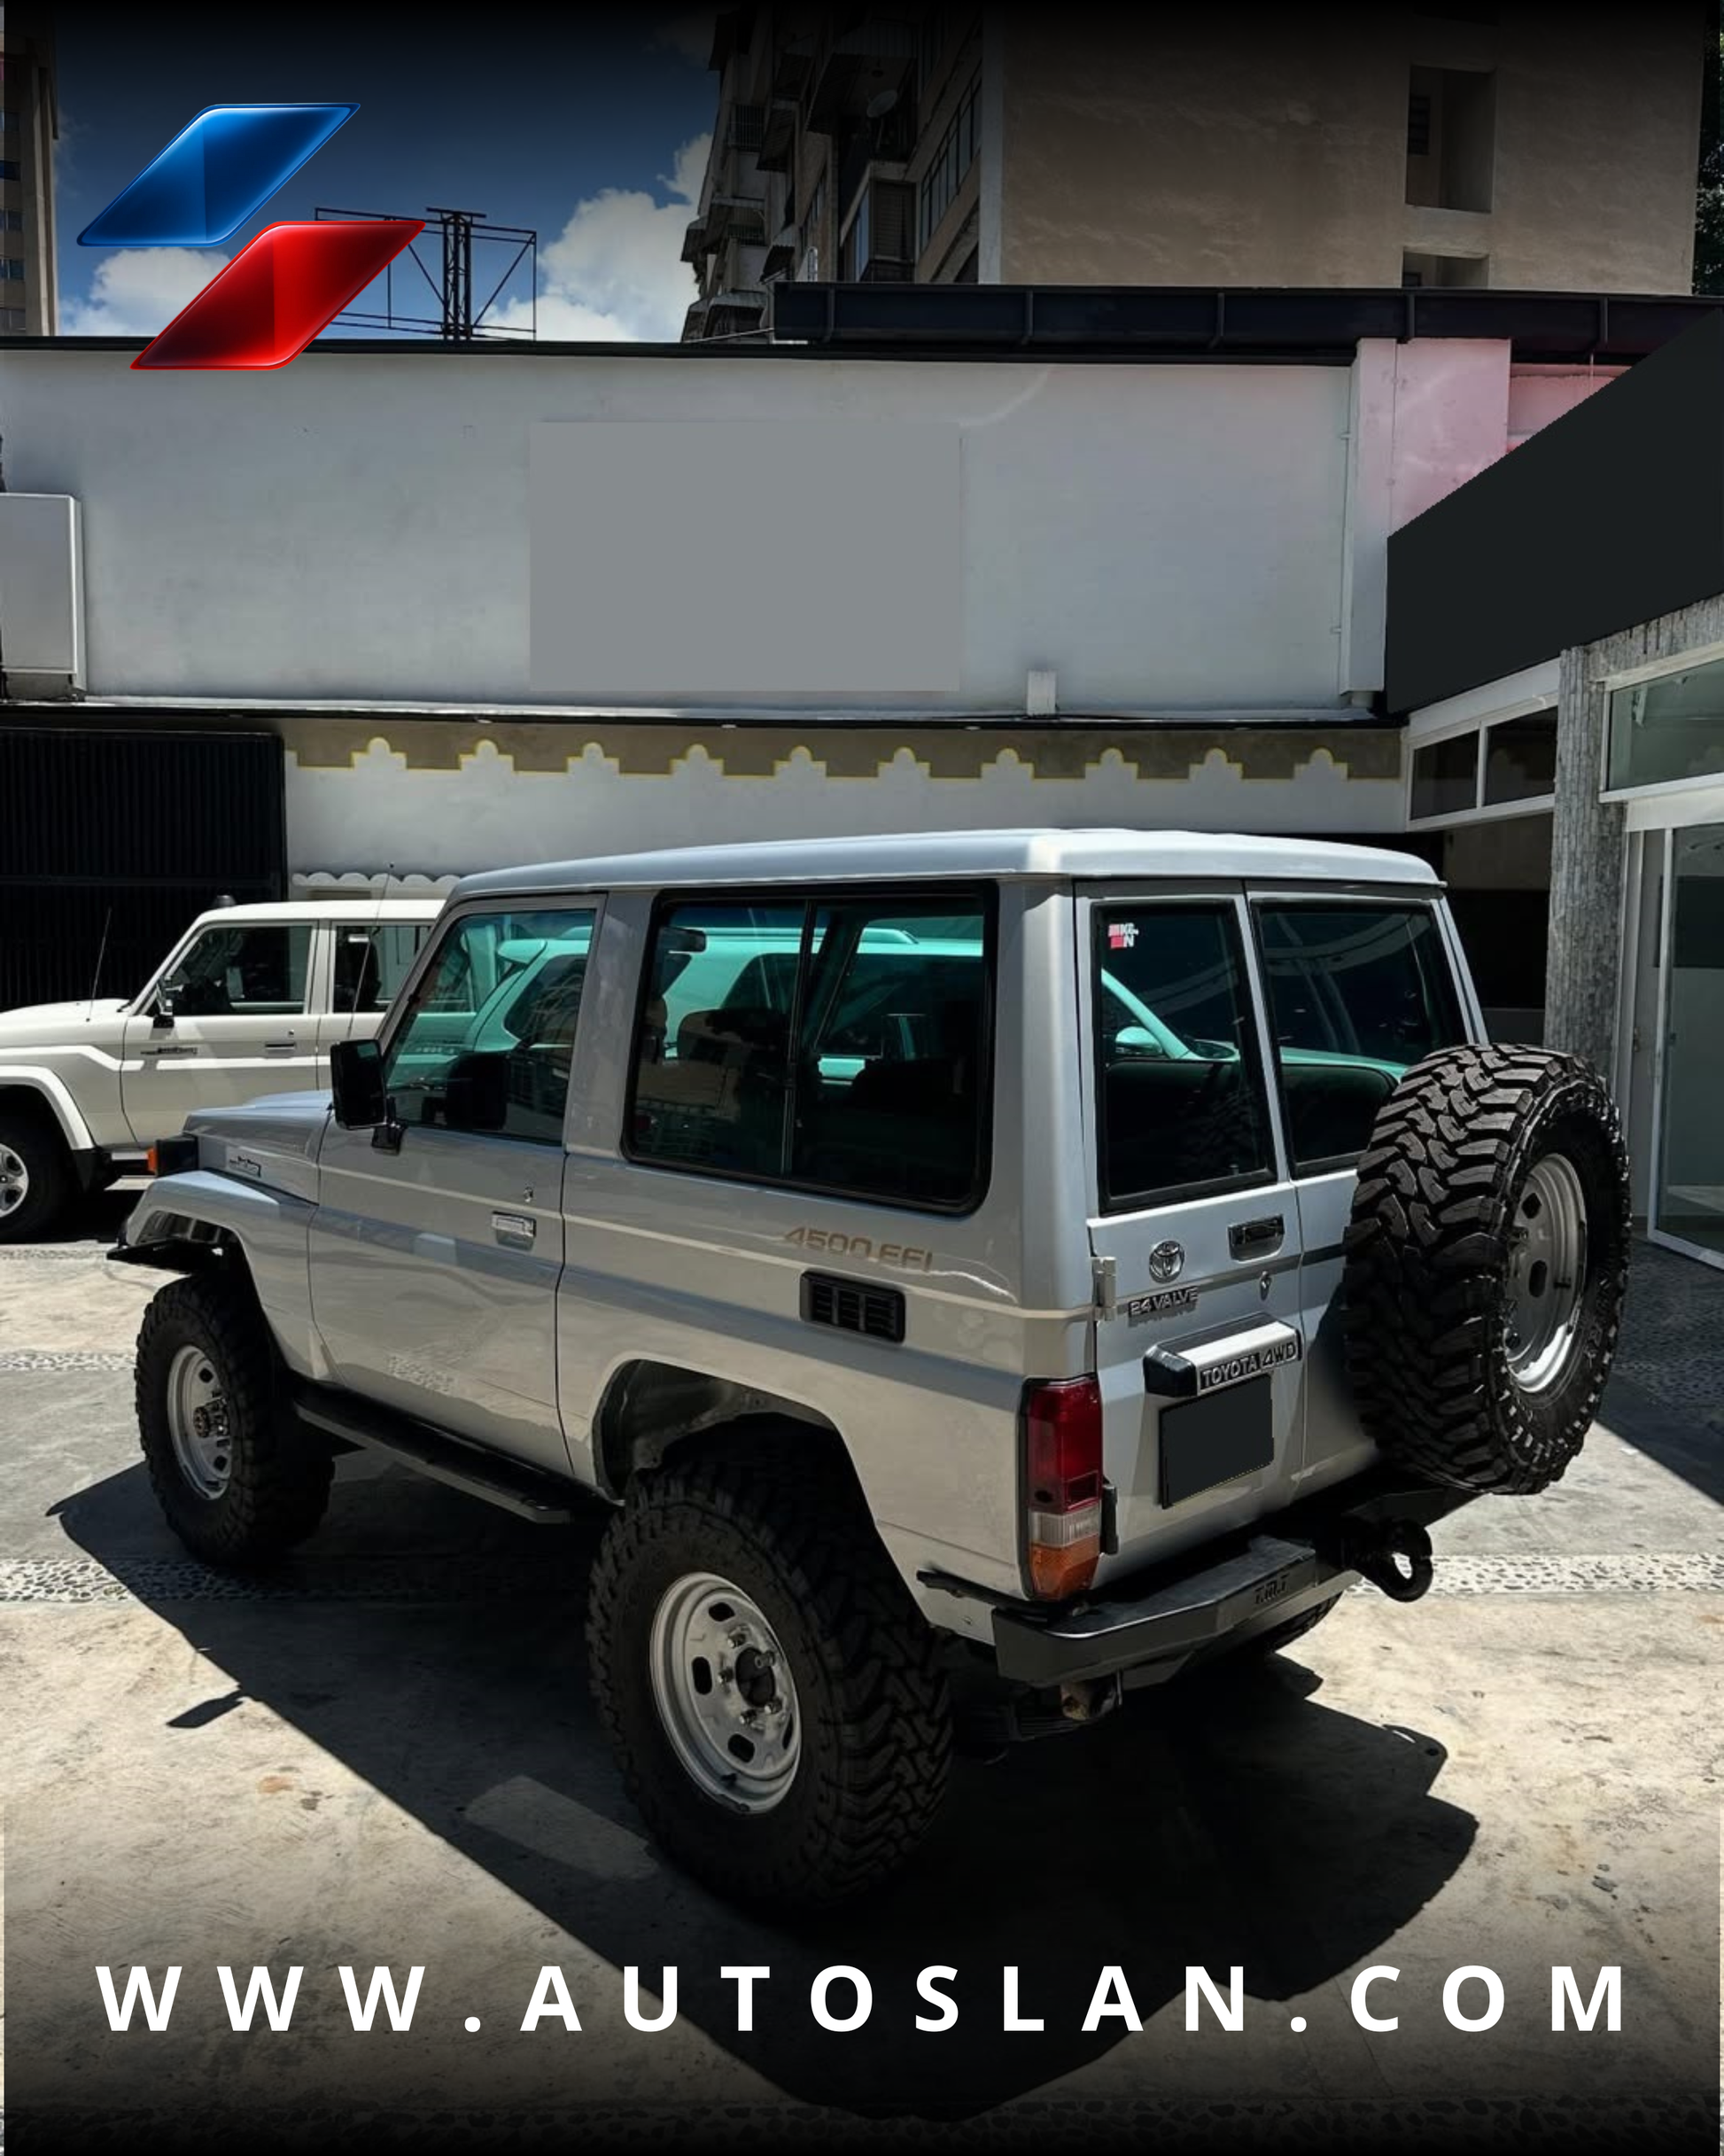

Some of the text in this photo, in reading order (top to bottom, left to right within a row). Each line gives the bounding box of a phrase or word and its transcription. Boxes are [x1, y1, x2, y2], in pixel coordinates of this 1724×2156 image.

[879, 1242, 933, 1272] EFI
[1130, 1286, 1200, 1316] 24 VALVE
[1202, 1343, 1297, 1387] TOYOTA 4WD
